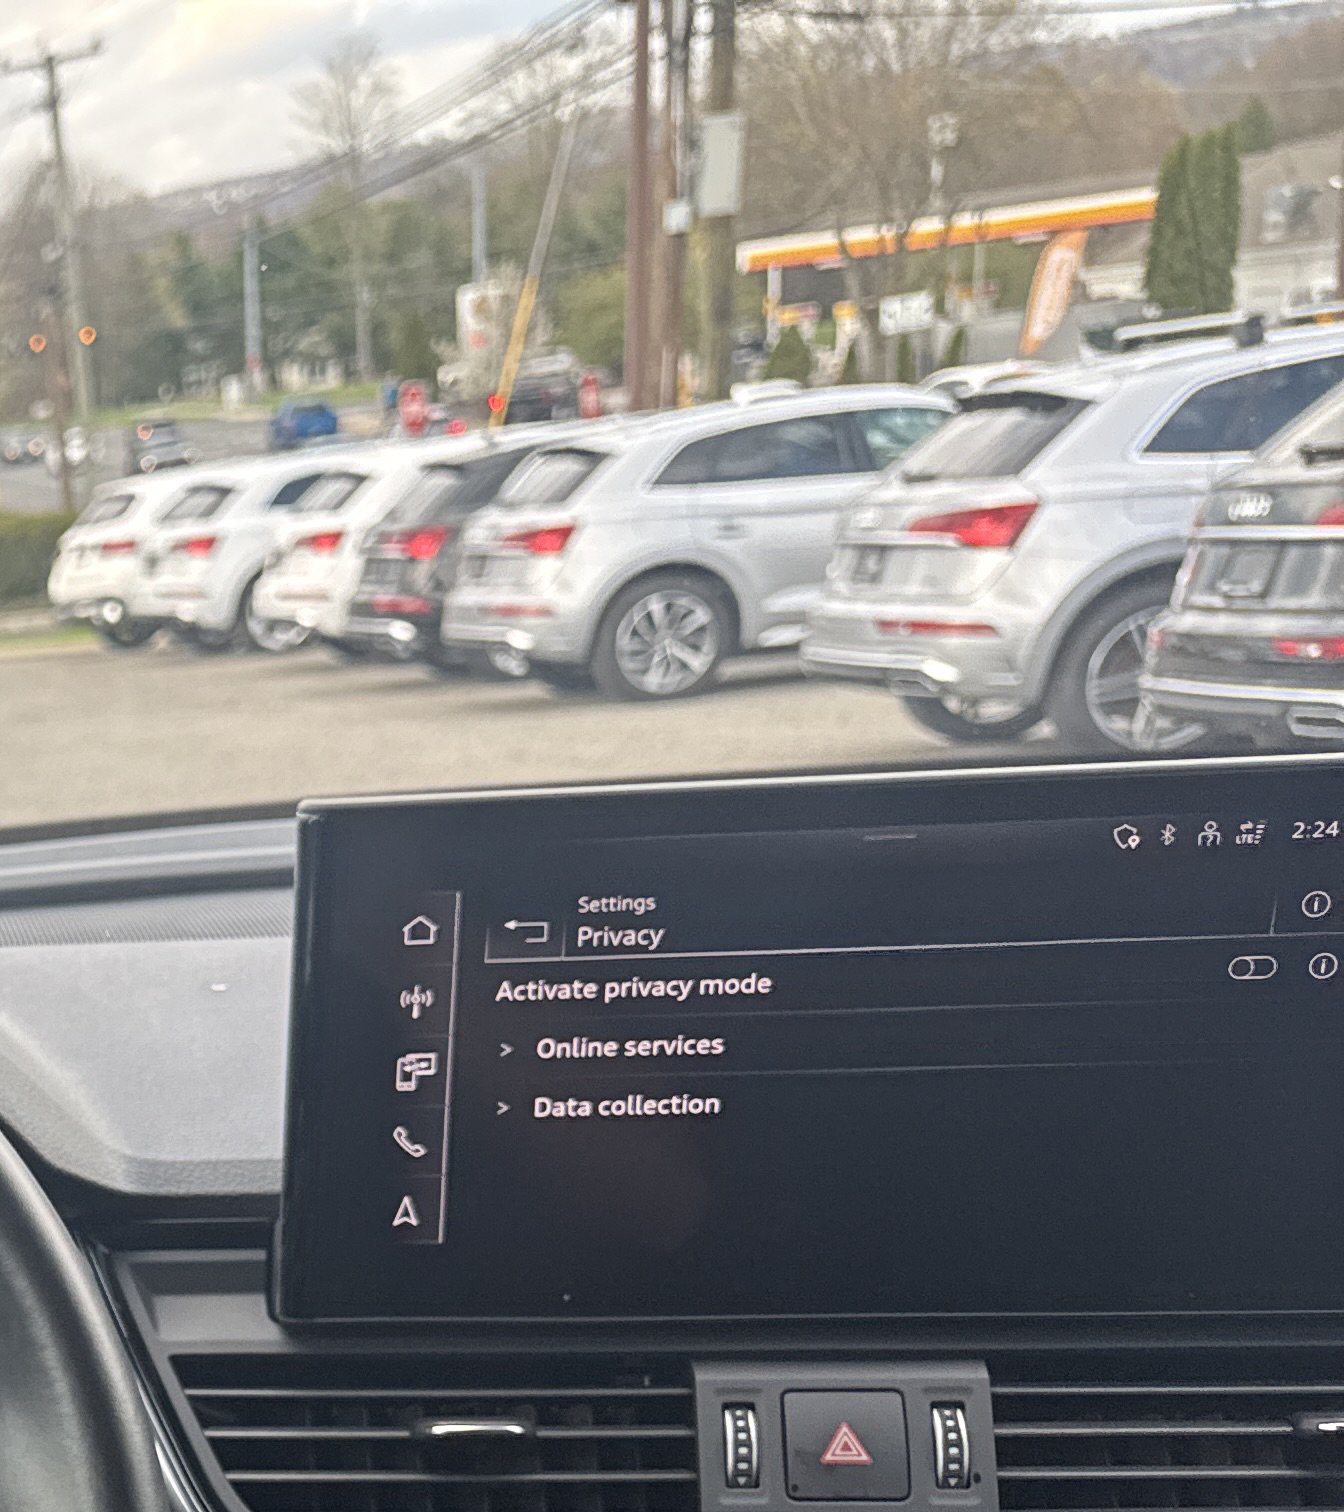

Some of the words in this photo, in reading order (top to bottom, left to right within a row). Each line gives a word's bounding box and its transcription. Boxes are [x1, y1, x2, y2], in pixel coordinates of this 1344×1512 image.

[1291, 821, 1339, 839] 2:24
[577, 896, 657, 916] Settings
[577, 926, 666, 950] Privacy
[495, 979, 598, 1002] Activate
[604, 976, 693, 1003] privacy
[699, 973, 773, 996] mode
[536, 1036, 620, 1059] Online
[623, 1034, 725, 1057] services
[533, 1096, 592, 1118] Data
[597, 1093, 722, 1116] collection
